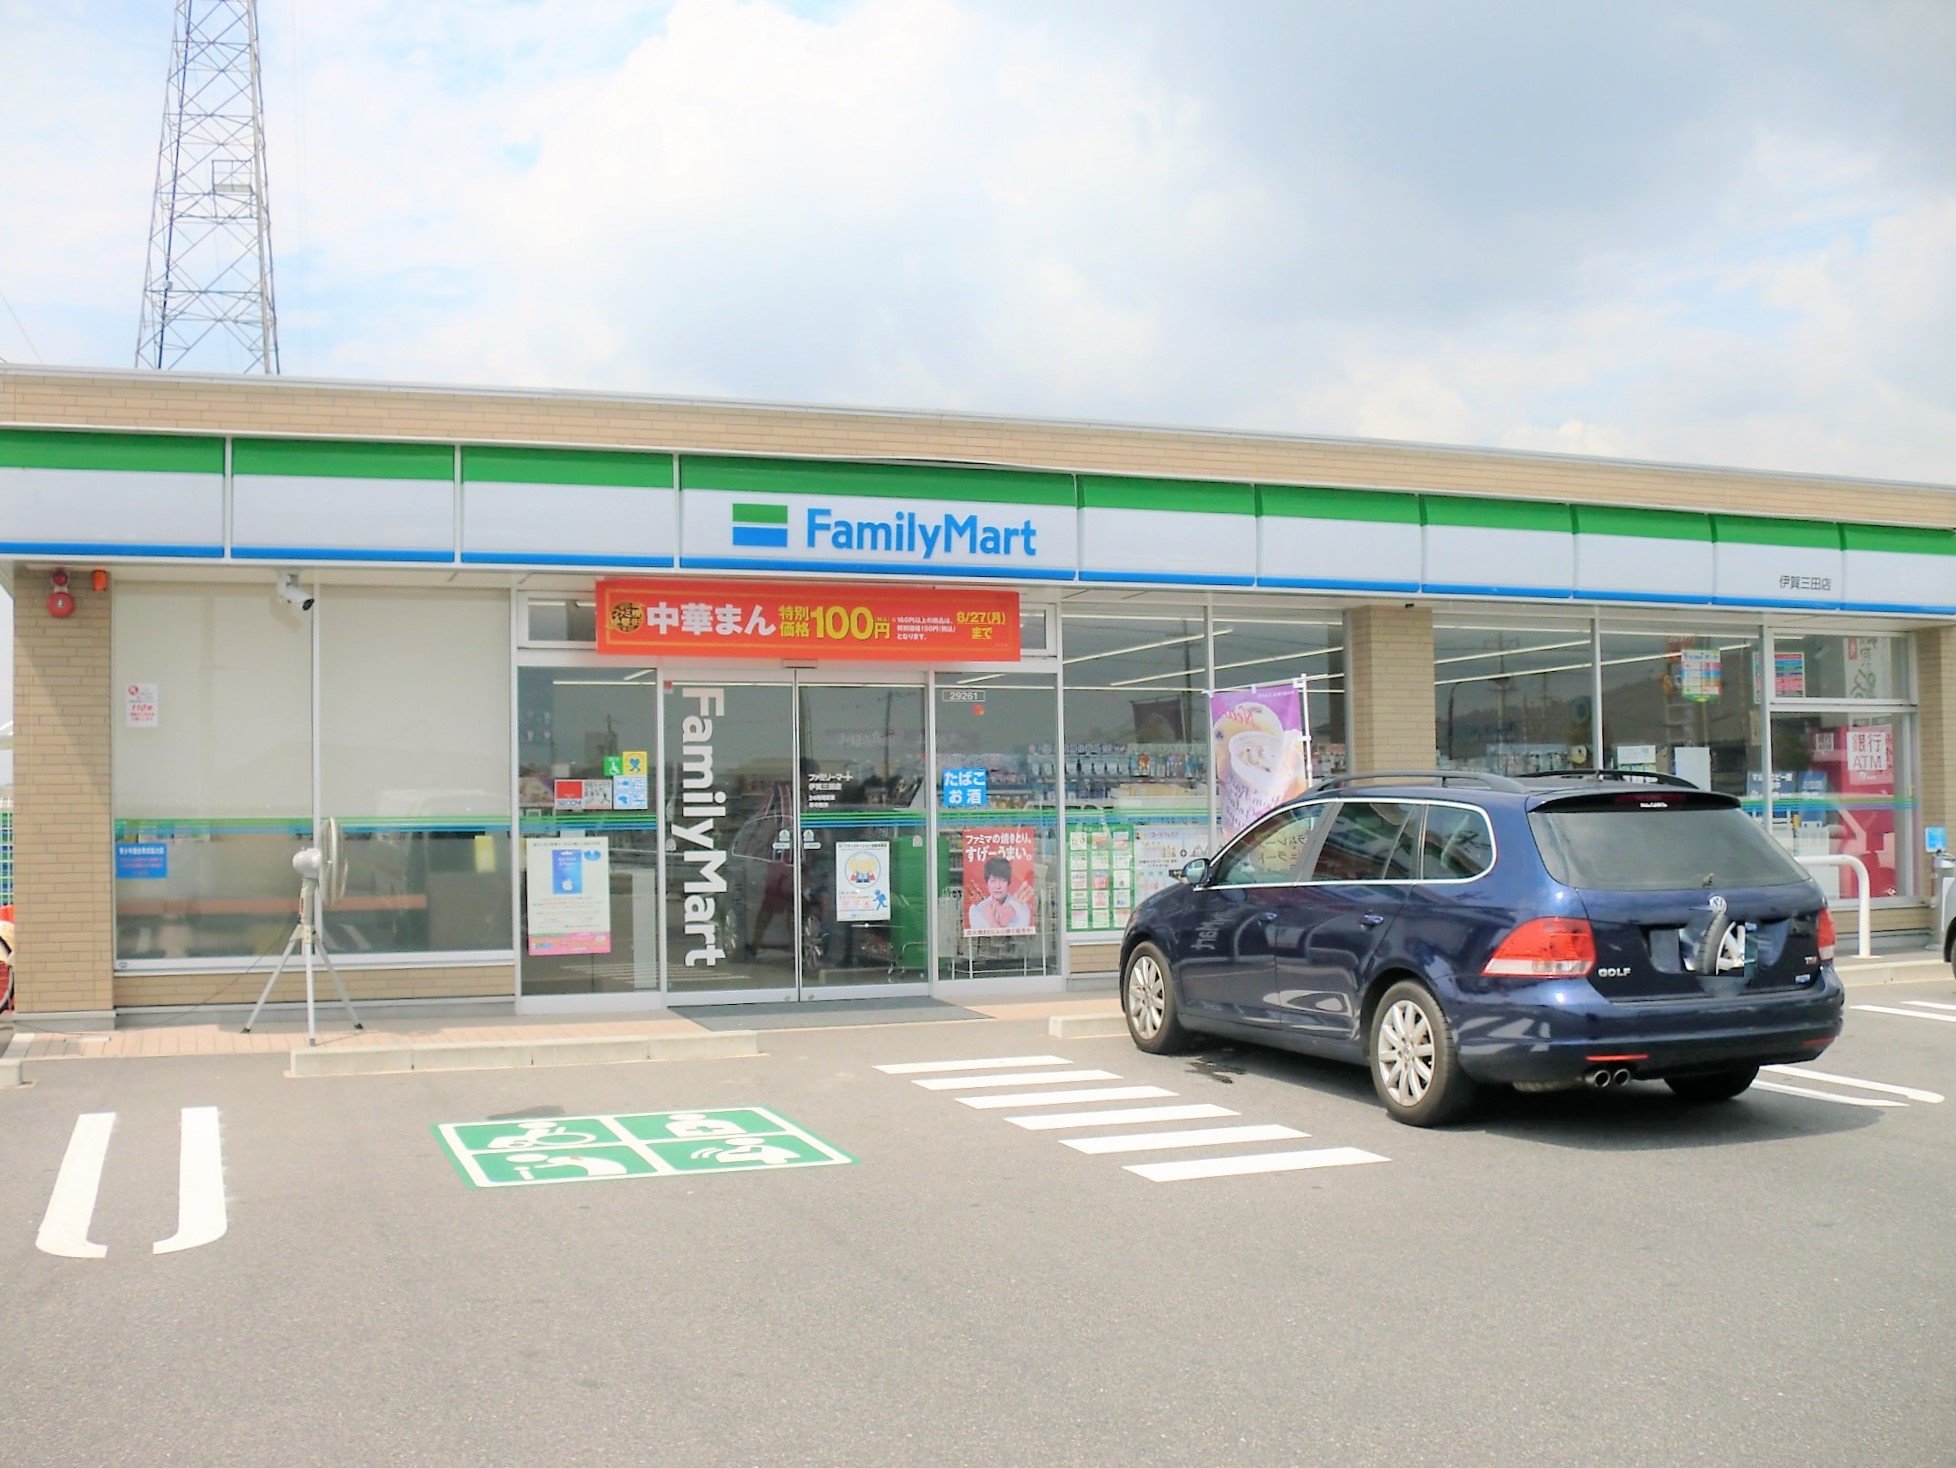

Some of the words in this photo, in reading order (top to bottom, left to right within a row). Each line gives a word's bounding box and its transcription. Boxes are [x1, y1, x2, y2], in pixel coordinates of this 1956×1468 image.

[807, 507, 1037, 559] FamilyMart
[646, 601, 777, 637] 中華まん
[779, 605, 810, 620] 特別
[779, 621, 810, 638] 価格
[971, 626, 993, 640] まで
[949, 692, 979, 701] 29261
[1852, 733, 1882, 753] 銀行
[1853, 755, 1882, 769] ATM
[944, 771, 986, 787] たばこ
[948, 788, 982, 805] お酒
[671, 687, 728, 967] FamilyMart
[1597, 967, 1631, 977] GOLF
